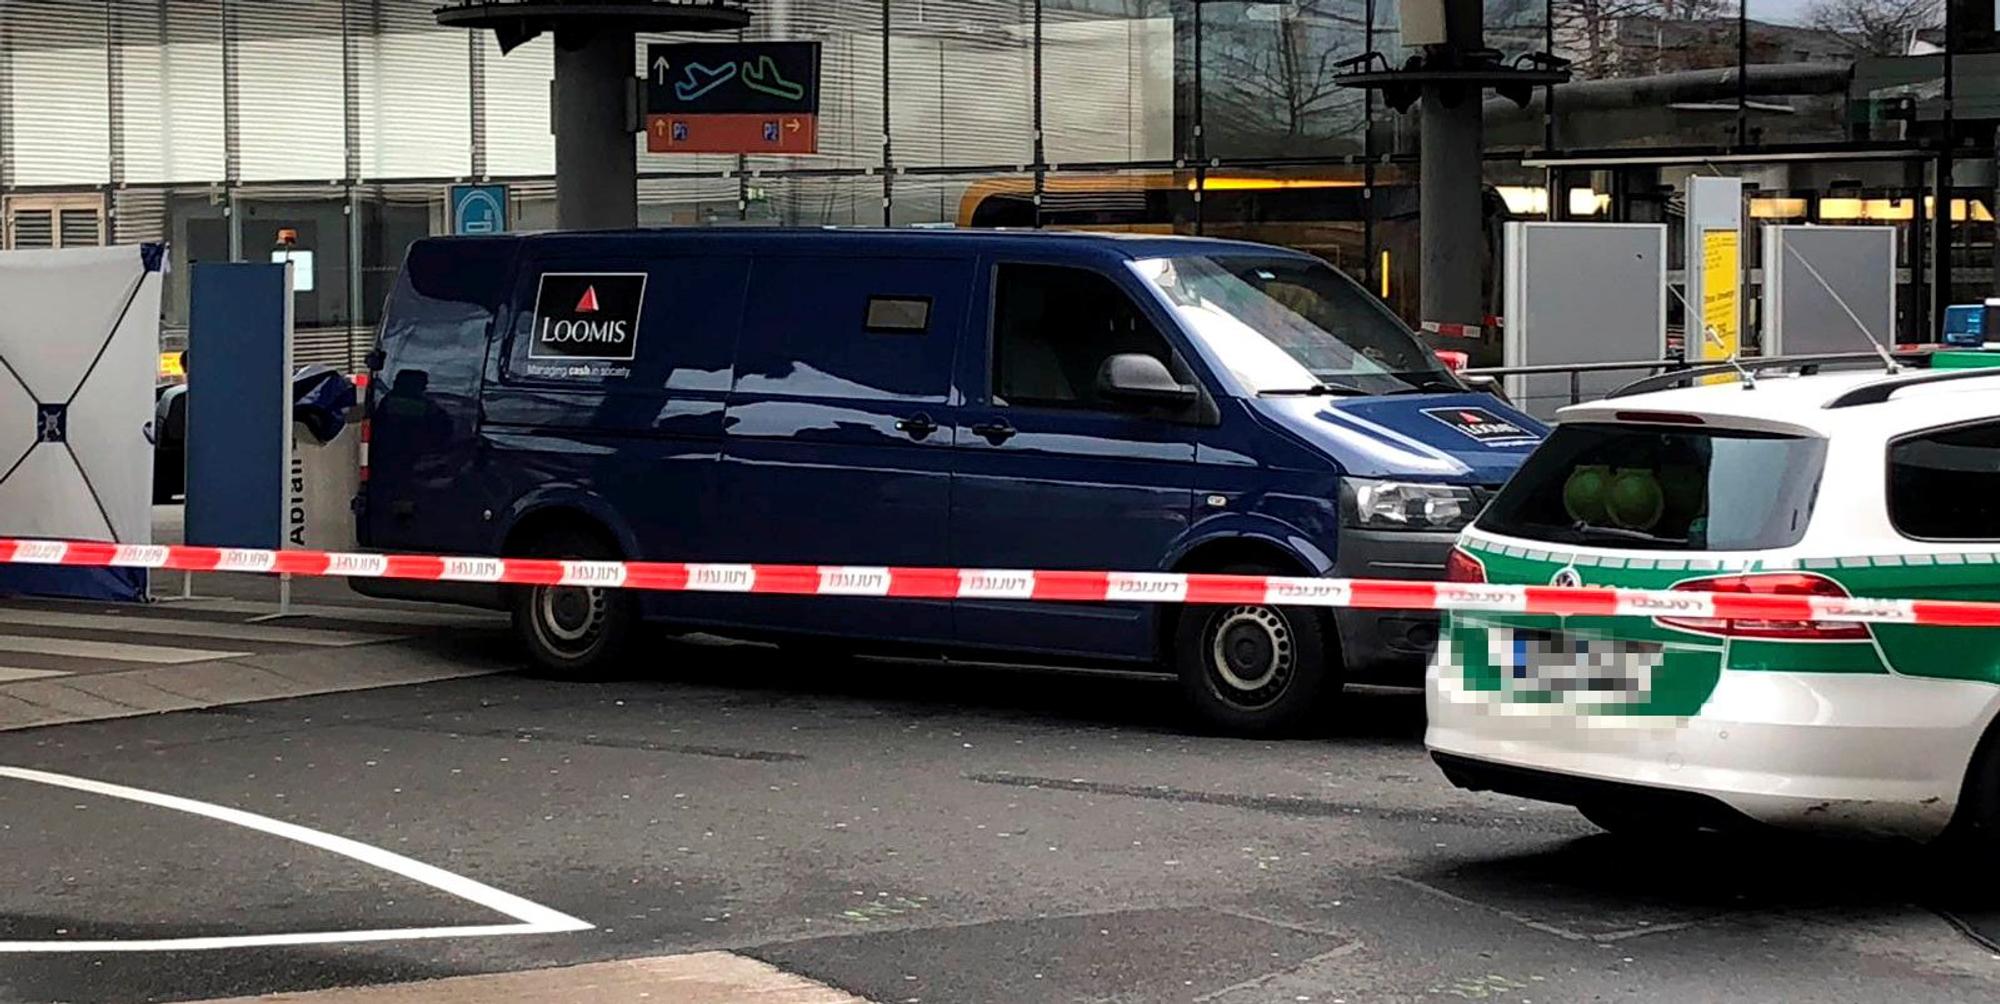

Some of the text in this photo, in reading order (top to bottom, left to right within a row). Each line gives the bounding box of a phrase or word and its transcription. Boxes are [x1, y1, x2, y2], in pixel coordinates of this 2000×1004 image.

[541, 316, 628, 343] LOOMIS
[527, 364, 567, 378] Managing
[568, 364, 590, 376] cash
